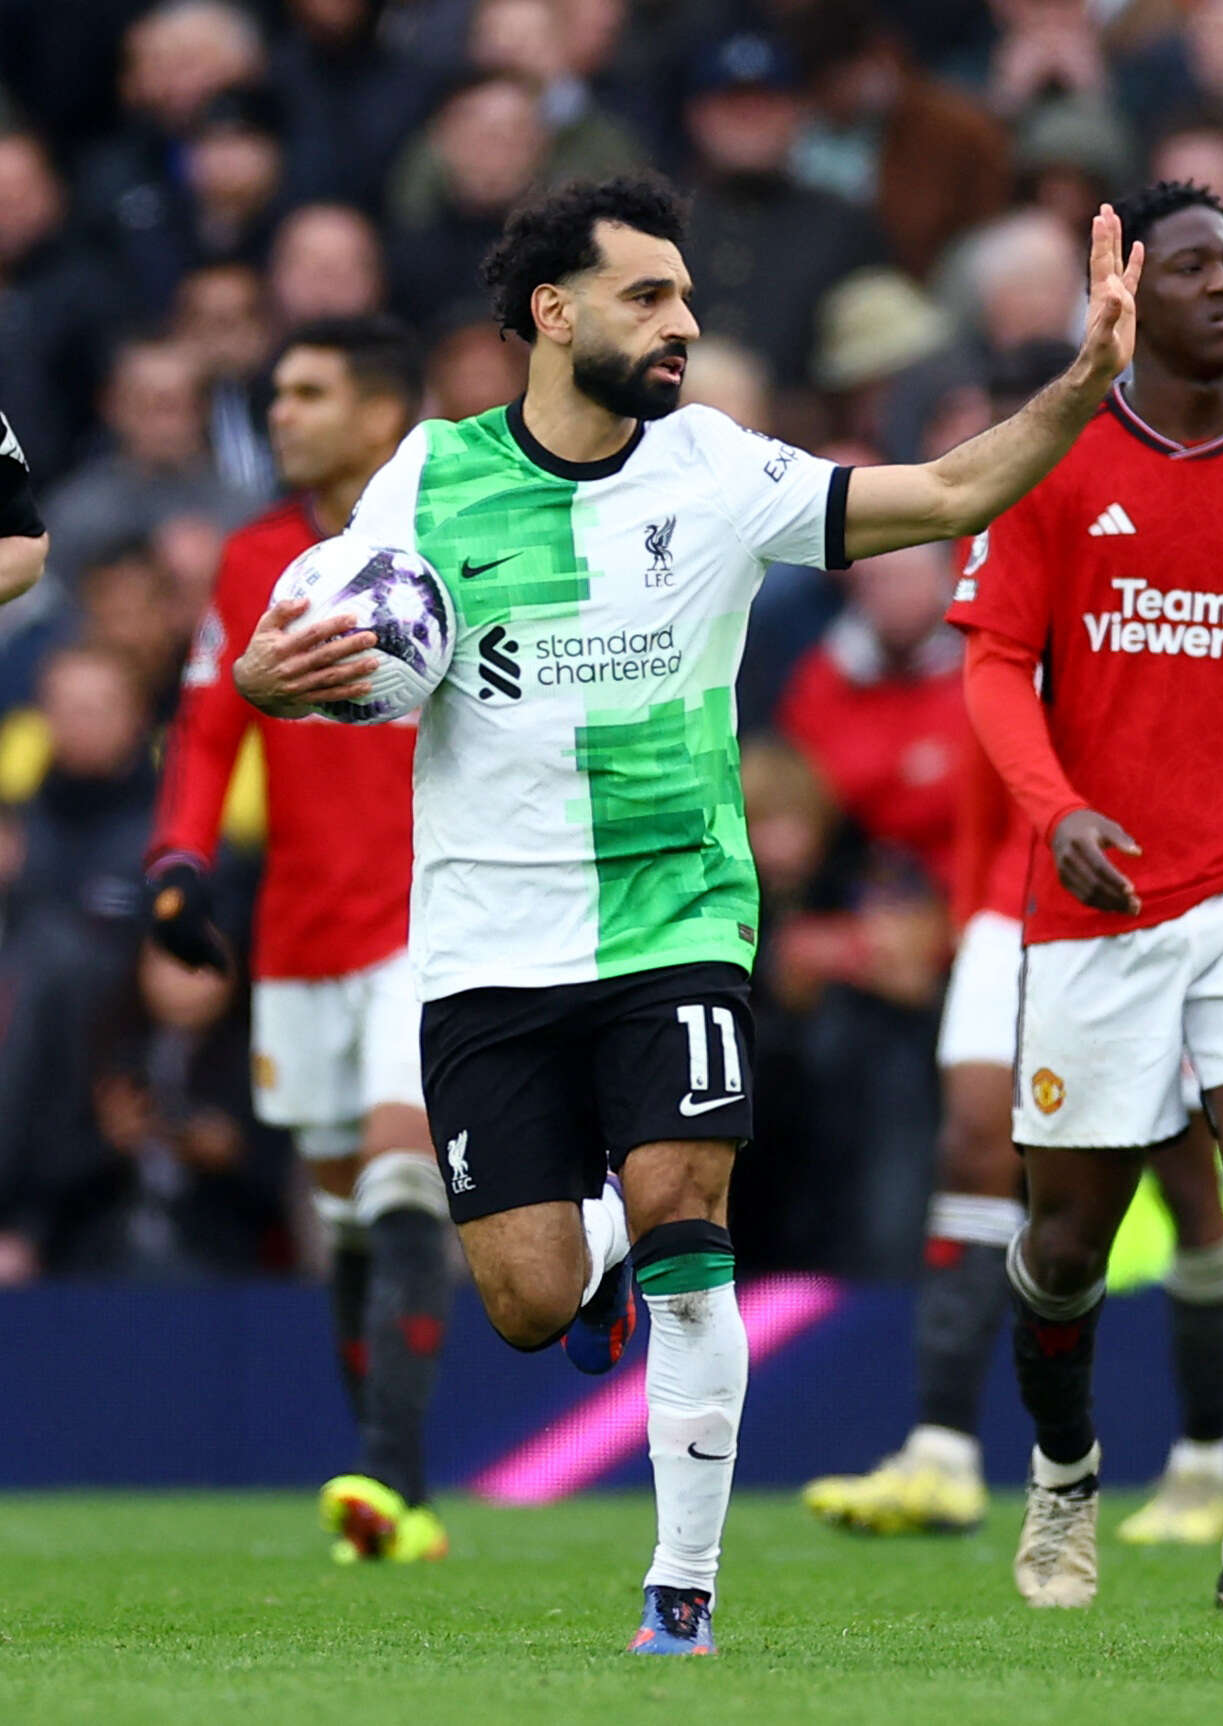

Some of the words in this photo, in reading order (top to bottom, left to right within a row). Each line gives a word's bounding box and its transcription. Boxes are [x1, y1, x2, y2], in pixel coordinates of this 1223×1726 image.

[644, 572, 676, 588] LFC
[536, 626, 675, 659] standard
[536, 652, 682, 686] chartered
[676, 1004, 742, 1092] 11
[451, 1177, 477, 1195] LFC
